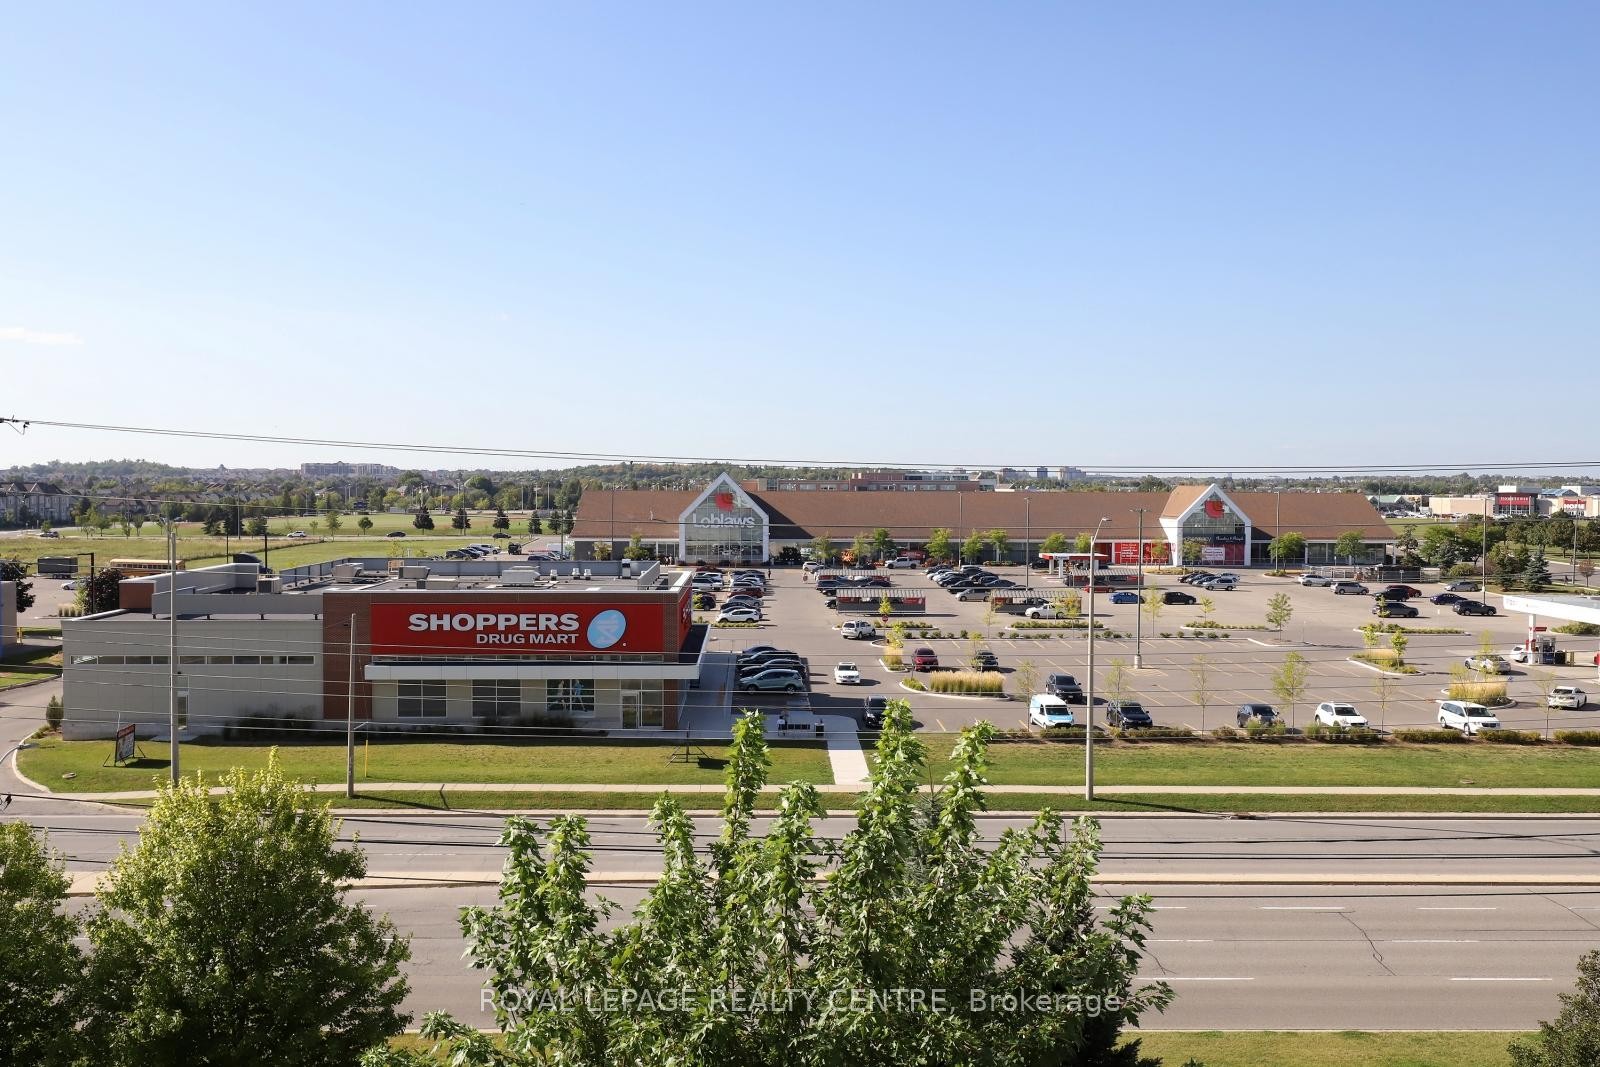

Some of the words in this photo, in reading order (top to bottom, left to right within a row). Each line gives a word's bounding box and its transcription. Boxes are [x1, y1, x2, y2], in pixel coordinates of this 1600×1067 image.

[692, 513, 756, 529] Loblaws
[408, 613, 580, 632] SHOPPERS
[476, 633, 525, 645] DRUG
[529, 633, 580, 645] MART
